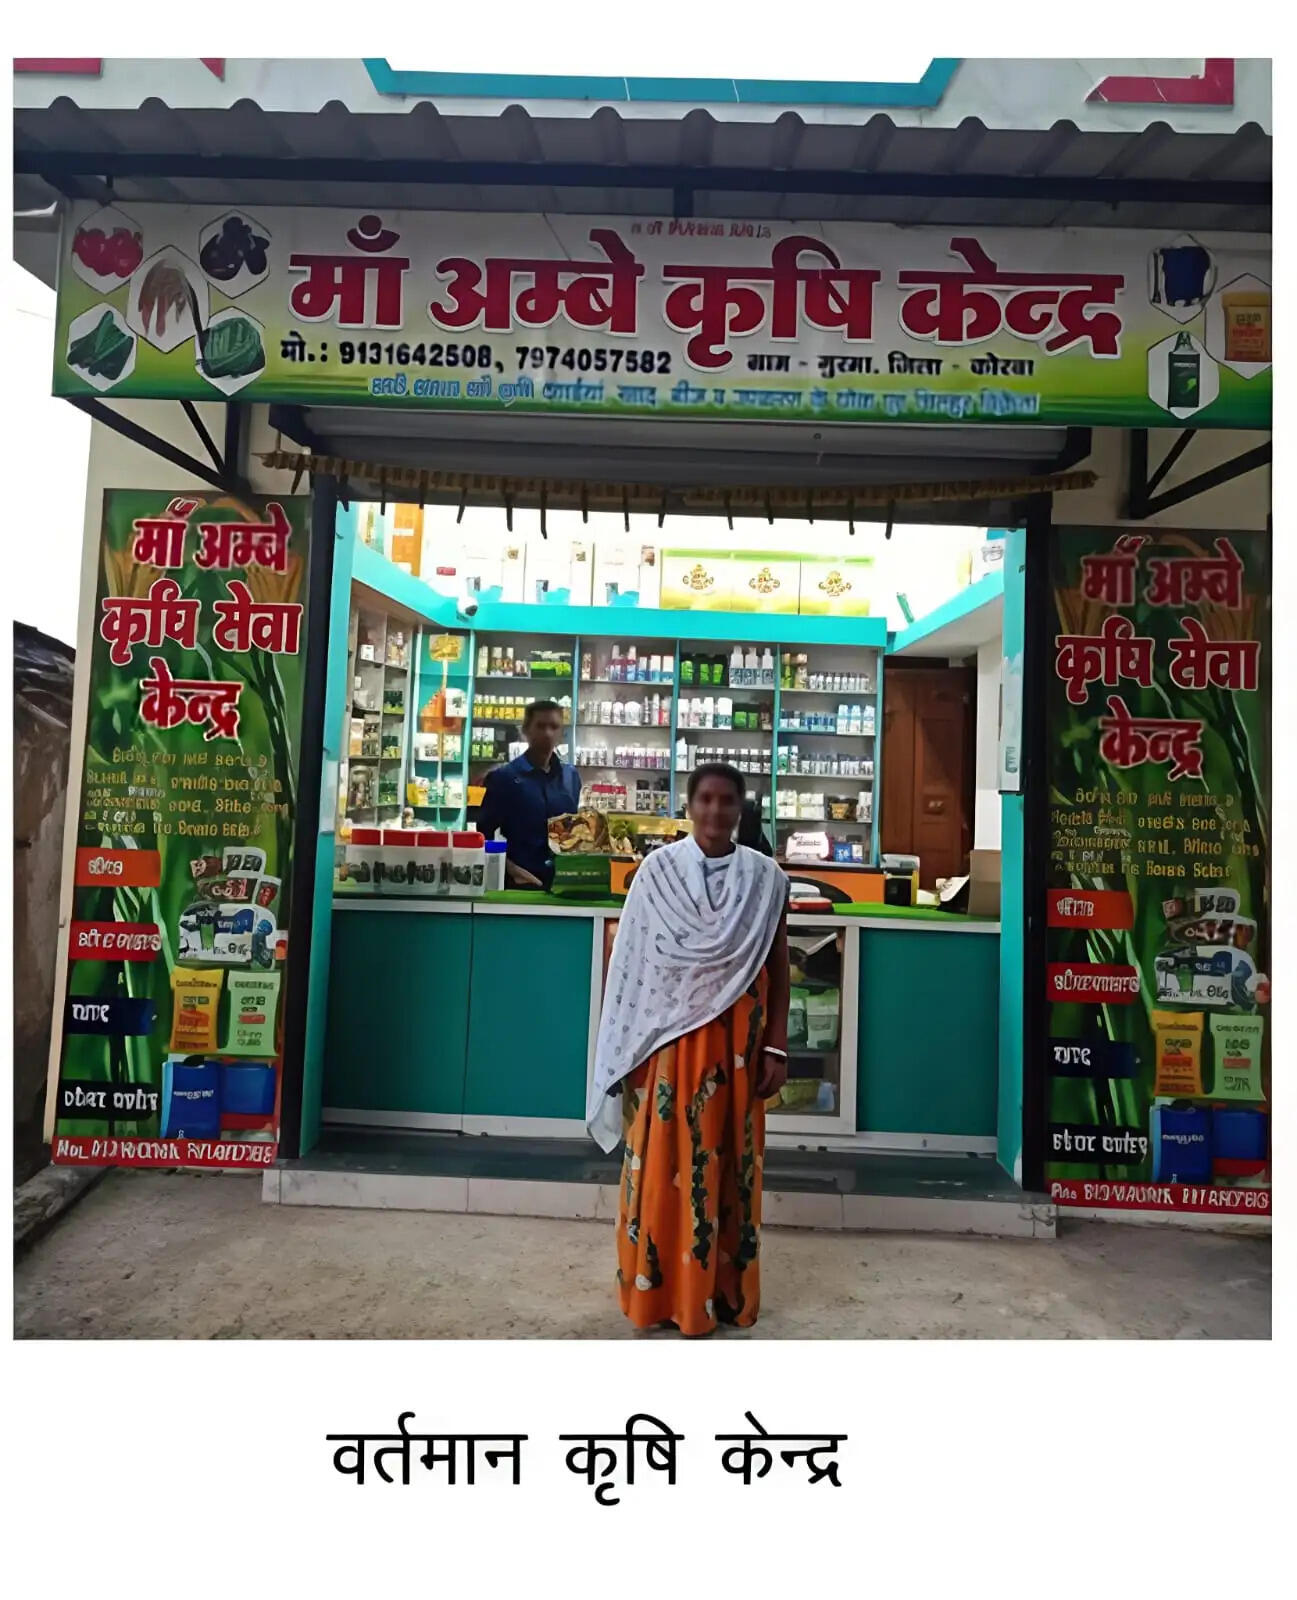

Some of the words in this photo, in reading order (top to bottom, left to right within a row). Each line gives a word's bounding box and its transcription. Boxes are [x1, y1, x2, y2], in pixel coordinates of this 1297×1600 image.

[428, 229, 645, 334] अम्बे
[662, 235, 881, 370] कृषि
[898, 237, 1125, 356] केन्द्र
[516, 346, 672, 374] 7974057582
[213, 580, 303, 654] सेवा
[1168, 617, 1260, 690] सेवा
